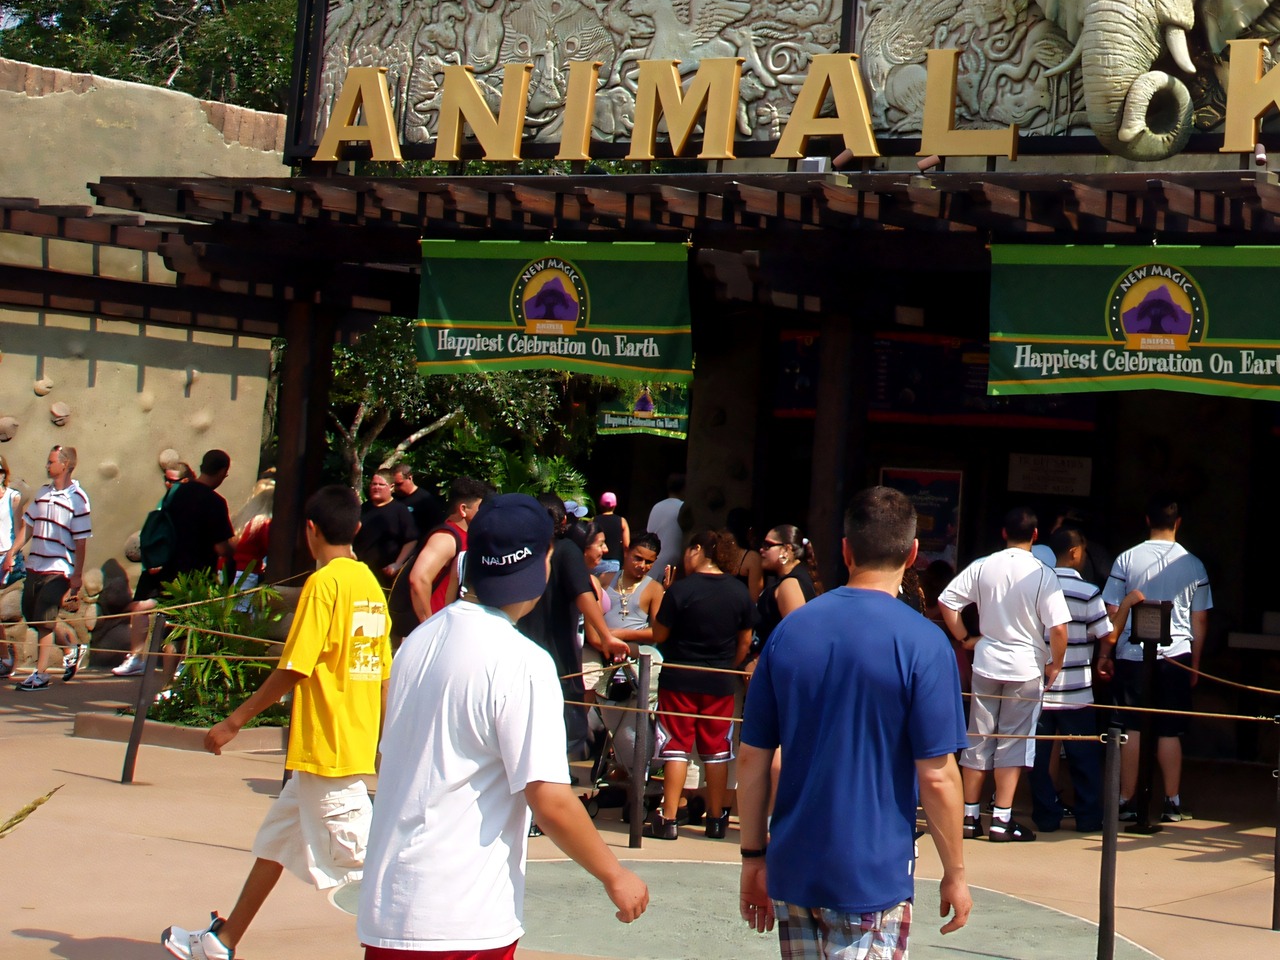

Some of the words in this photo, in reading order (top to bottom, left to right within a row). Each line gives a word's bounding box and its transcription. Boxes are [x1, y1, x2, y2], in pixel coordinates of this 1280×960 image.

[312, 49, 1019, 162] ANIMAL
[522, 259, 545, 283] NEW
[547, 258, 579, 283] MAGIC
[1120, 266, 1147, 292] NEW
[1151, 265, 1193, 292] MAGIC
[437, 329, 503, 357] Happiest
[507, 333, 586, 355] Celebration
[592, 338, 610, 356] On
[614, 335, 660, 357] Earth
[1013, 344, 1098, 375] Happiest
[1103, 349, 1203, 373] Celebration
[1210, 353, 1233, 374] On
[481, 546, 533, 565] NAUTICA
